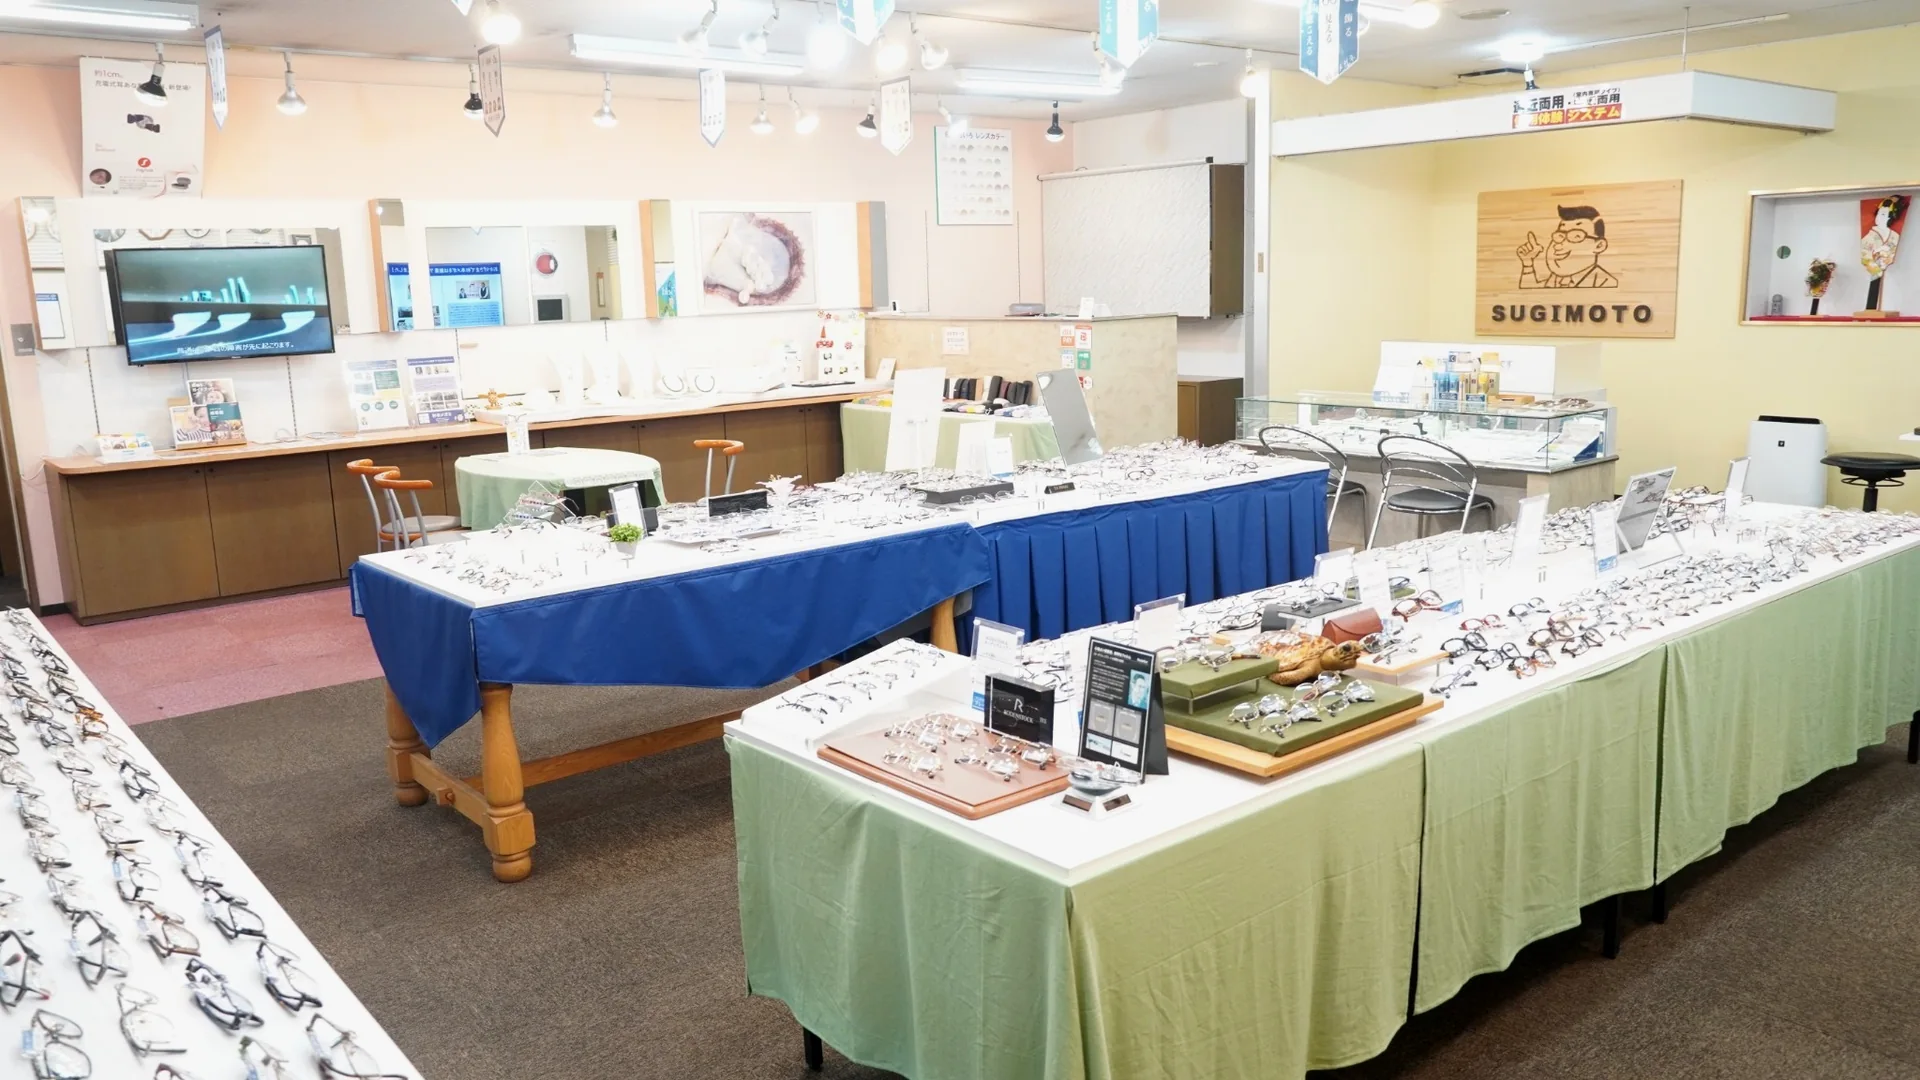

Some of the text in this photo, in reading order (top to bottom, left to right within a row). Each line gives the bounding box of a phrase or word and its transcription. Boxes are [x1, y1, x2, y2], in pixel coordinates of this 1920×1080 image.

[1567, 106, 1620, 121] システム
[1492, 305, 1652, 323] SUGIMOTO
